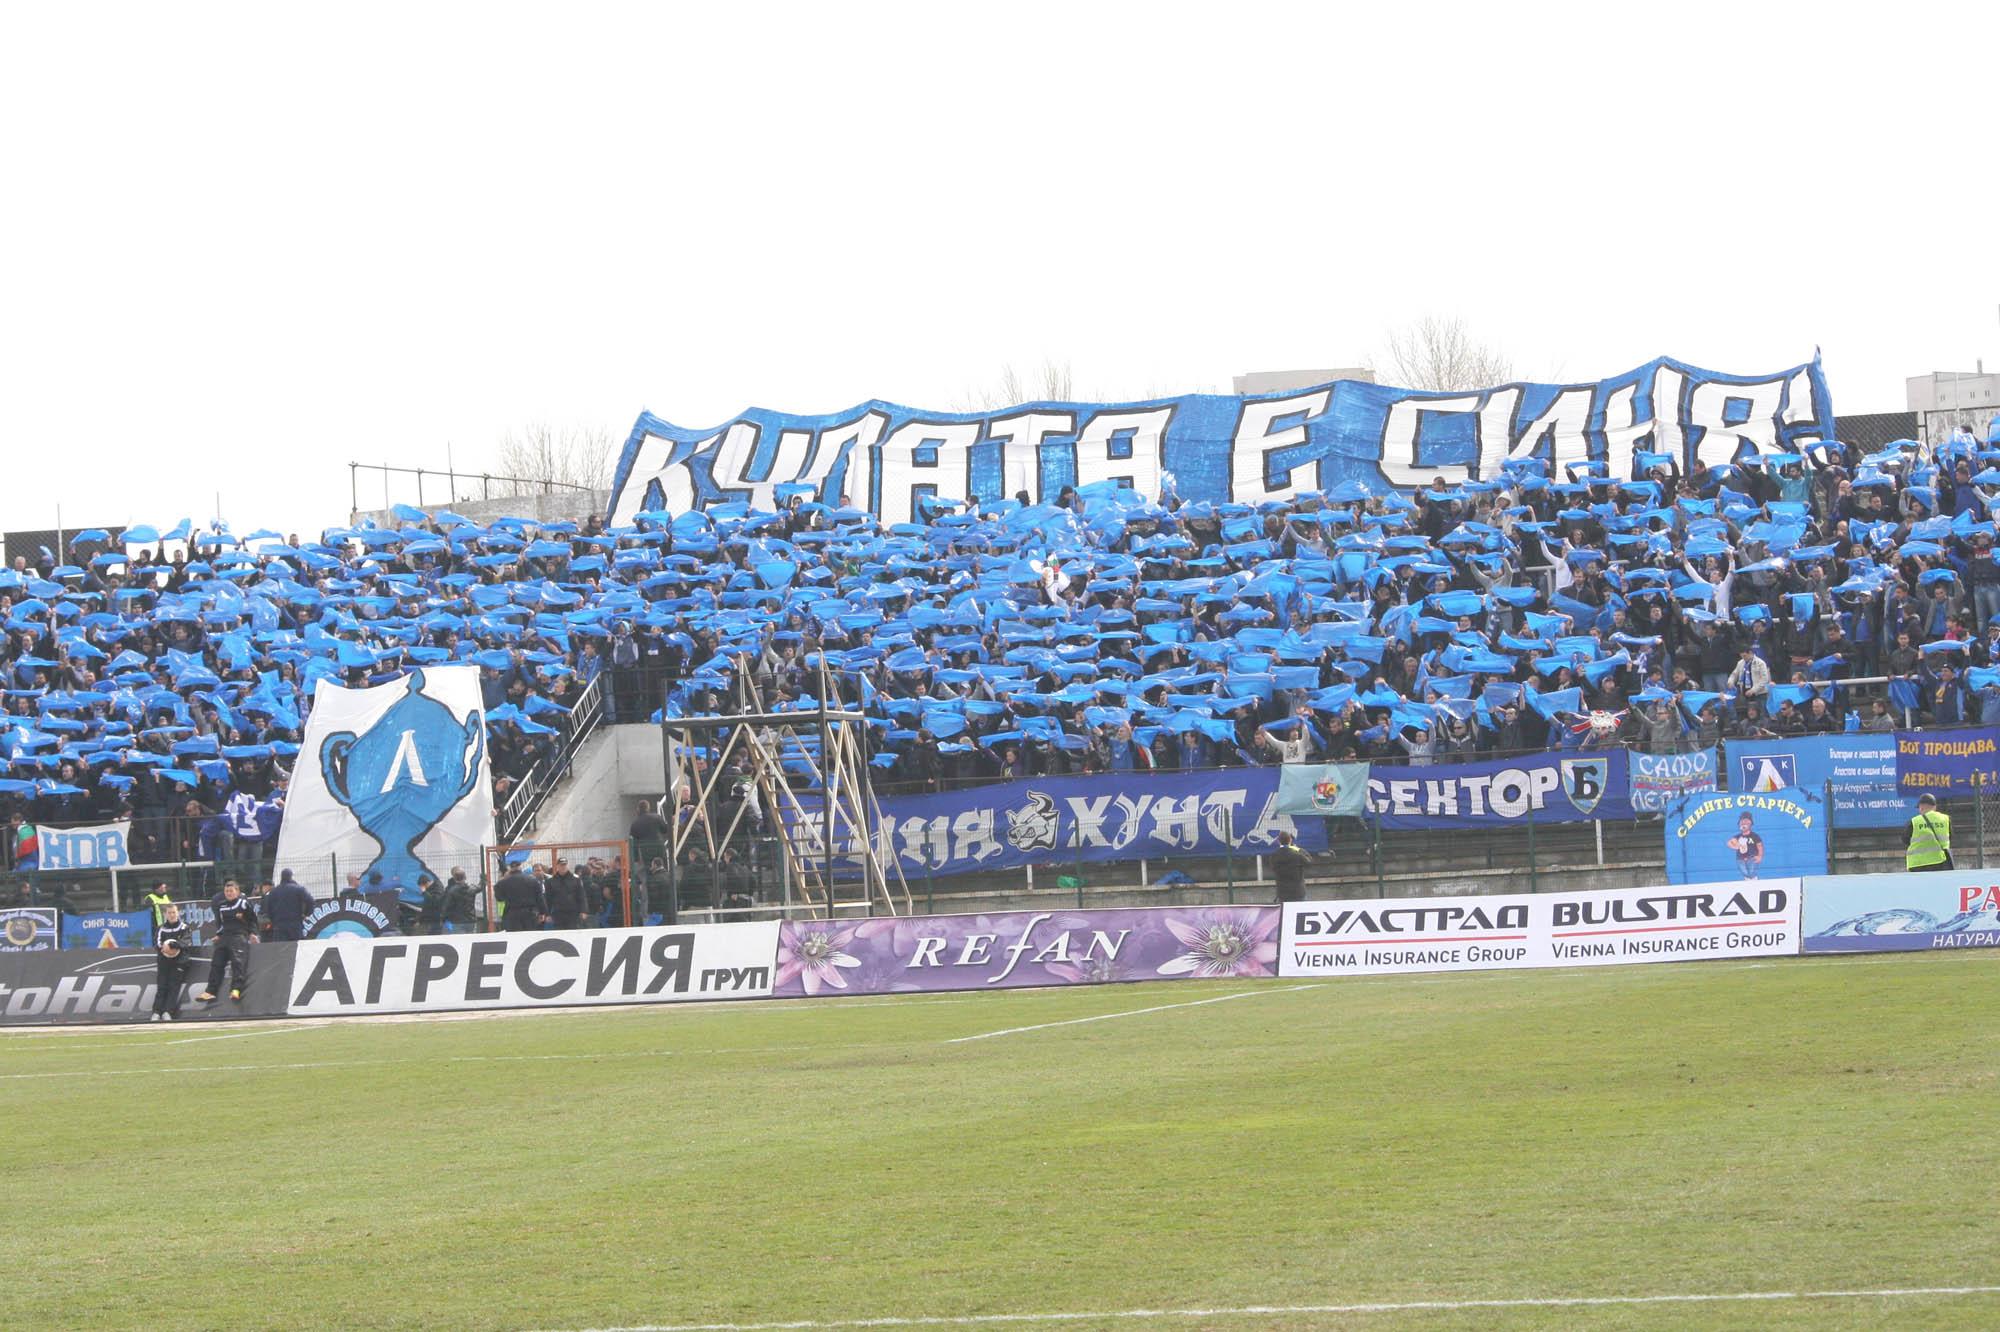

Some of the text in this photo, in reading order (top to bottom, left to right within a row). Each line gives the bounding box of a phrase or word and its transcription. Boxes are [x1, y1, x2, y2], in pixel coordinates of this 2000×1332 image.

[609, 405, 1177, 528] КУЛАТА
[1228, 384, 1337, 505] Е
[1638, 751, 1709, 777] САМО
[1902, 772, 1952, 787] ЛЕВСКИ
[1366, 767, 1559, 818] СЕКТОР
[1736, 795, 1813, 830] СТАРЧЕТА
[82, 917, 129, 929] СИНЯ ЗОНА
[345, 898, 390, 930] LEVSKI
[1296, 904, 1529, 936] БУЛСТРАД
[1552, 888, 1788, 927] BULSTRAD
[1294, 946, 1528, 968] VIENNA INSURANCE GROUP
[1552, 932, 1786, 959] VIENNA INSURANCE GROUP
[293, 932, 769, 1007] АГРЕСИЯ ГРУП
